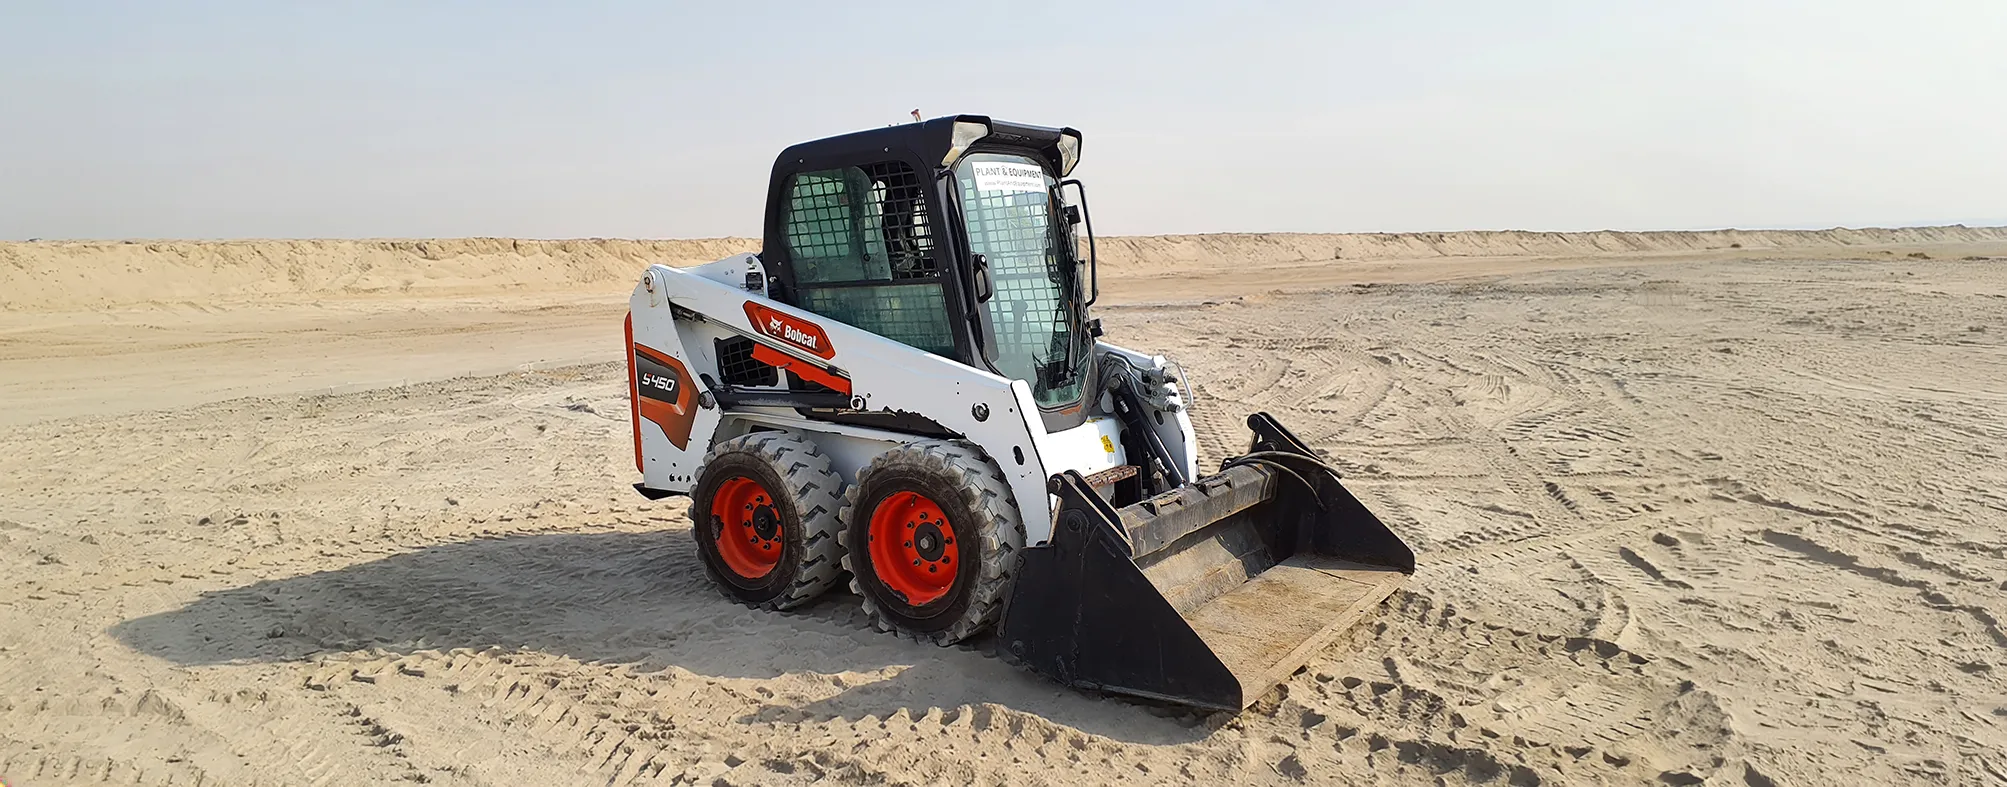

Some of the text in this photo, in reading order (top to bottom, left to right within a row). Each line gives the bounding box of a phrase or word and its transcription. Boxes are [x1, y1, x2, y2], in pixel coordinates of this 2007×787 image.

[975, 167, 1042, 179] PLANT & EQUIPMENT
[784, 324, 817, 348] Bobcat
[641, 372, 676, 392] S450
